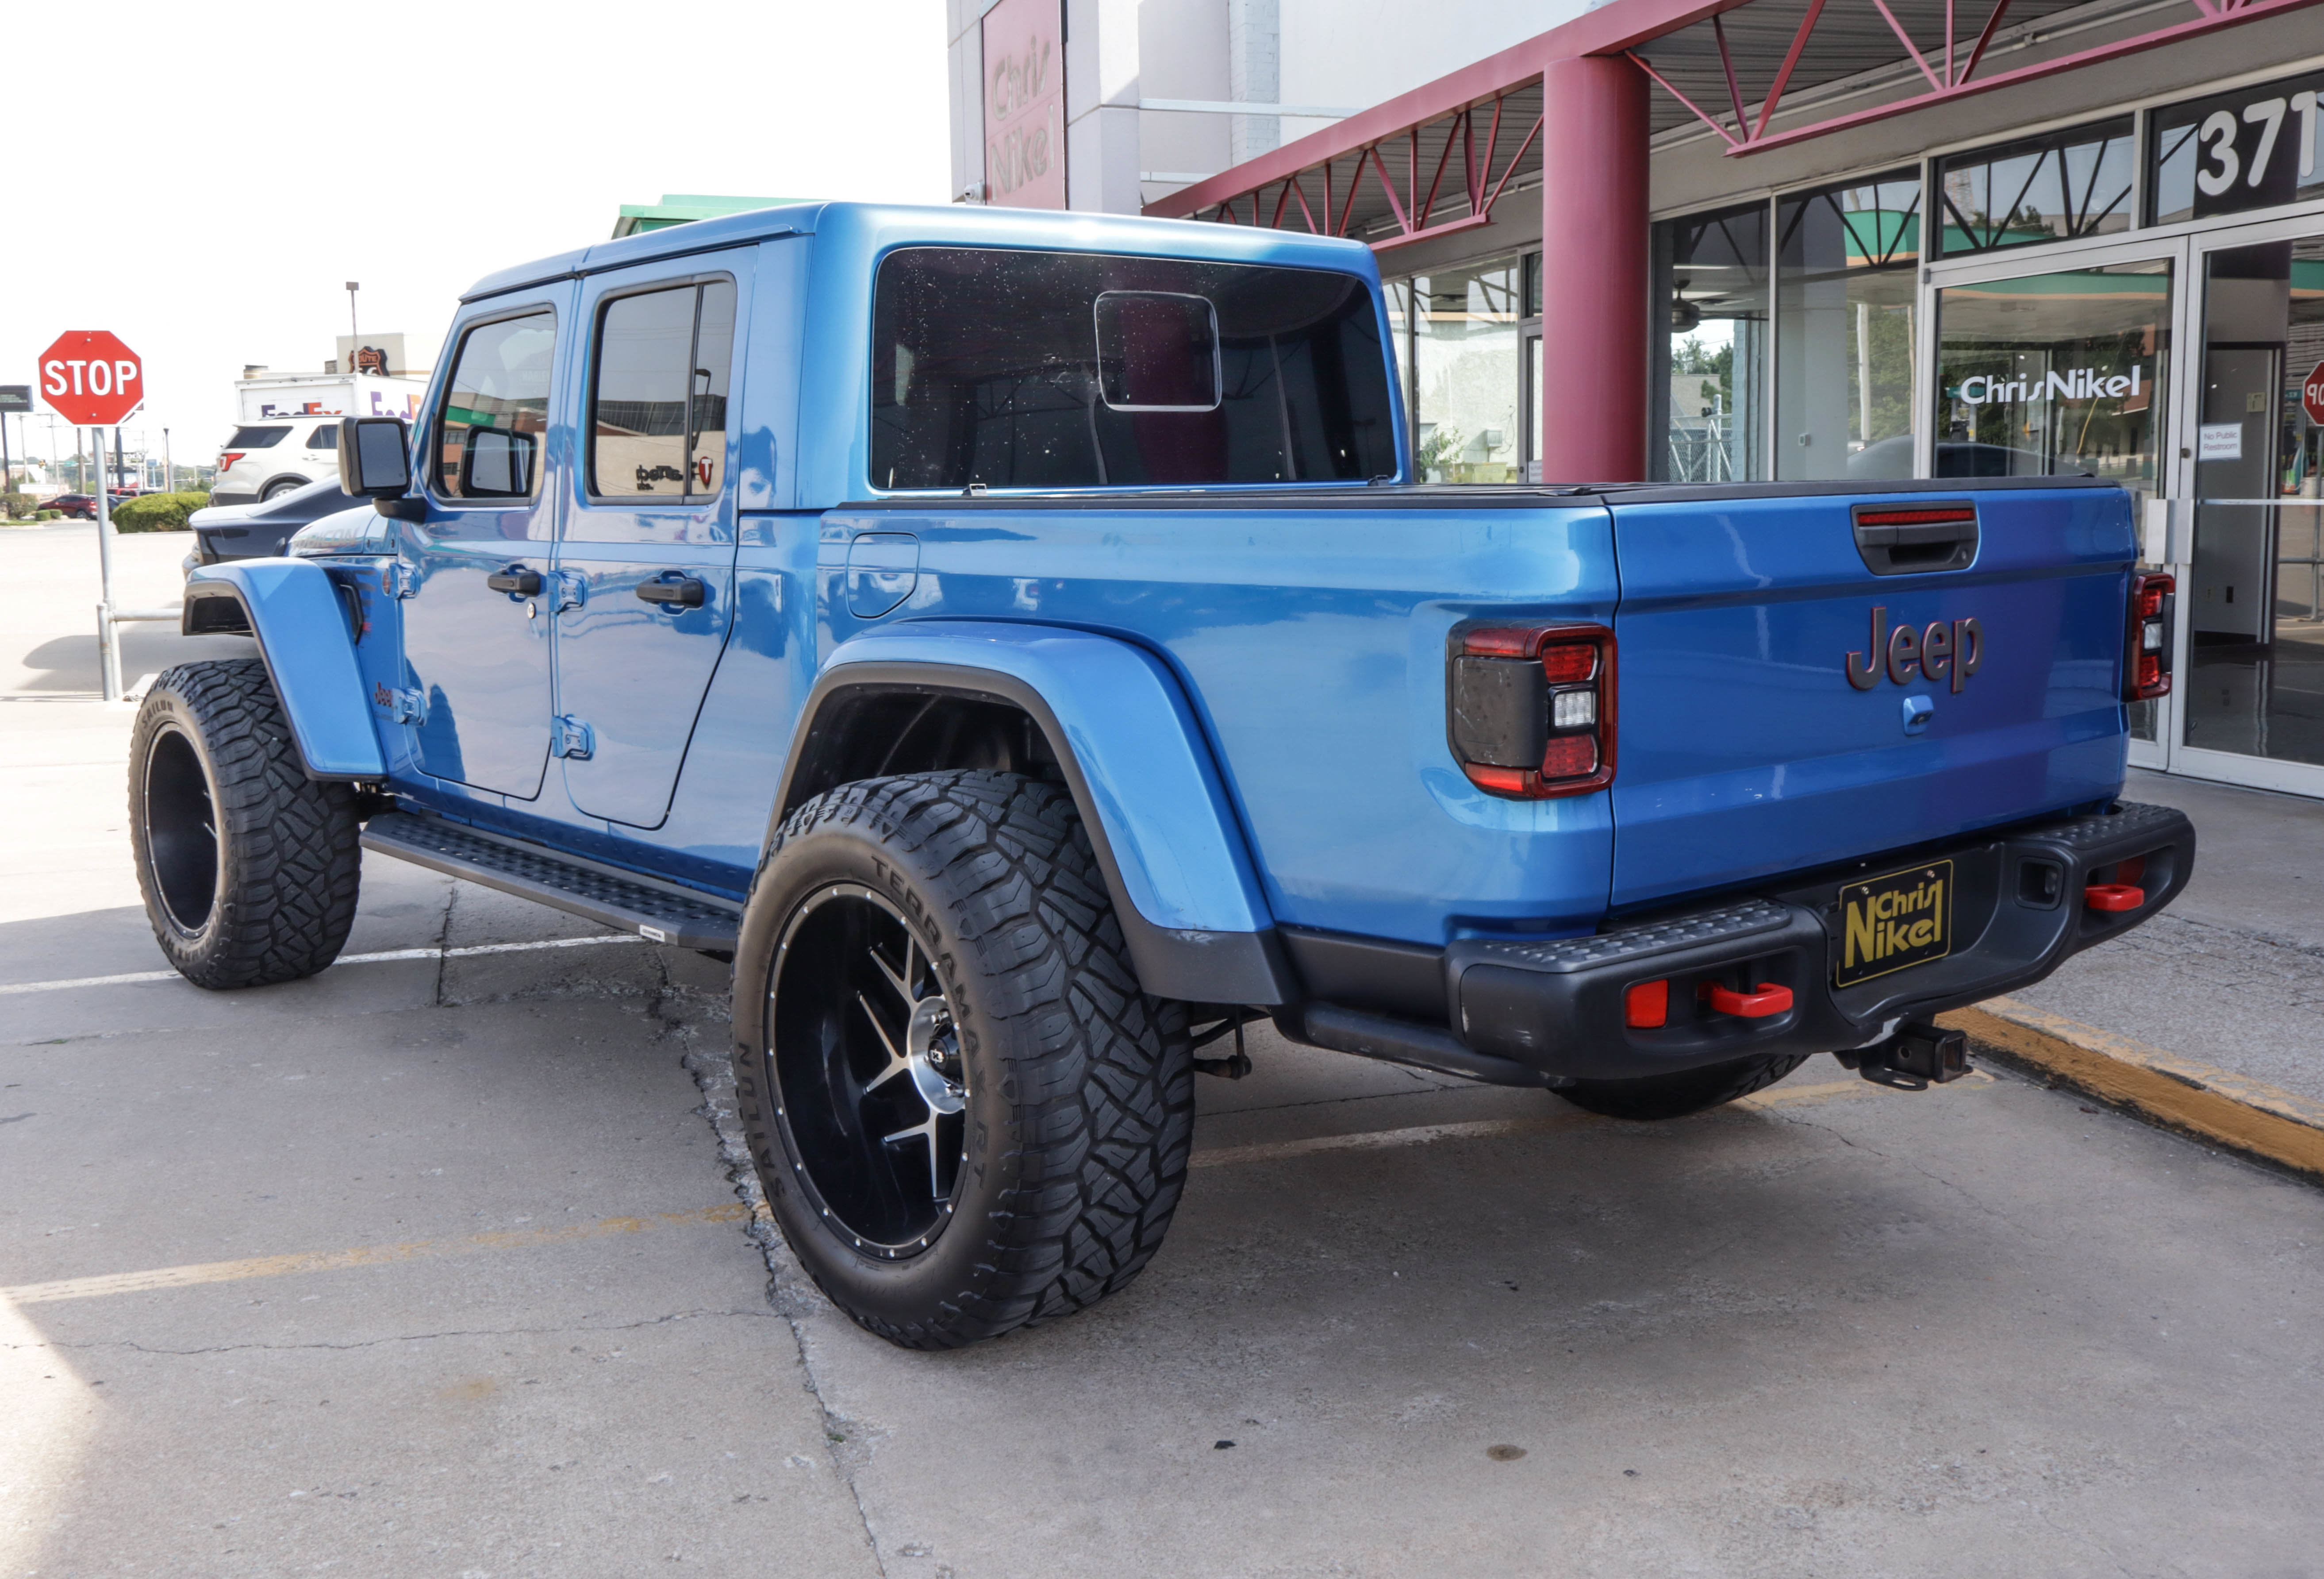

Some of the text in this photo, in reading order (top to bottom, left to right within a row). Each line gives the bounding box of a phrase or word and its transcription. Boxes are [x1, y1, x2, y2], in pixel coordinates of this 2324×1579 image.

[992, 35, 1050, 121] Chris
[991, 103, 1055, 201] Nikel
[2197, 90, 2317, 196] 371
[45, 359, 138, 396] STOP
[2216, 431, 2238, 439] Public
[1846, 606, 1984, 693] Jeep
[142, 700, 174, 729] SAILUN
[374, 682, 392, 708] Jee
[1844, 879, 1943, 968] Nikel
[1875, 881, 1937, 920] Chris
[738, 1042, 785, 1198] SAILUN
